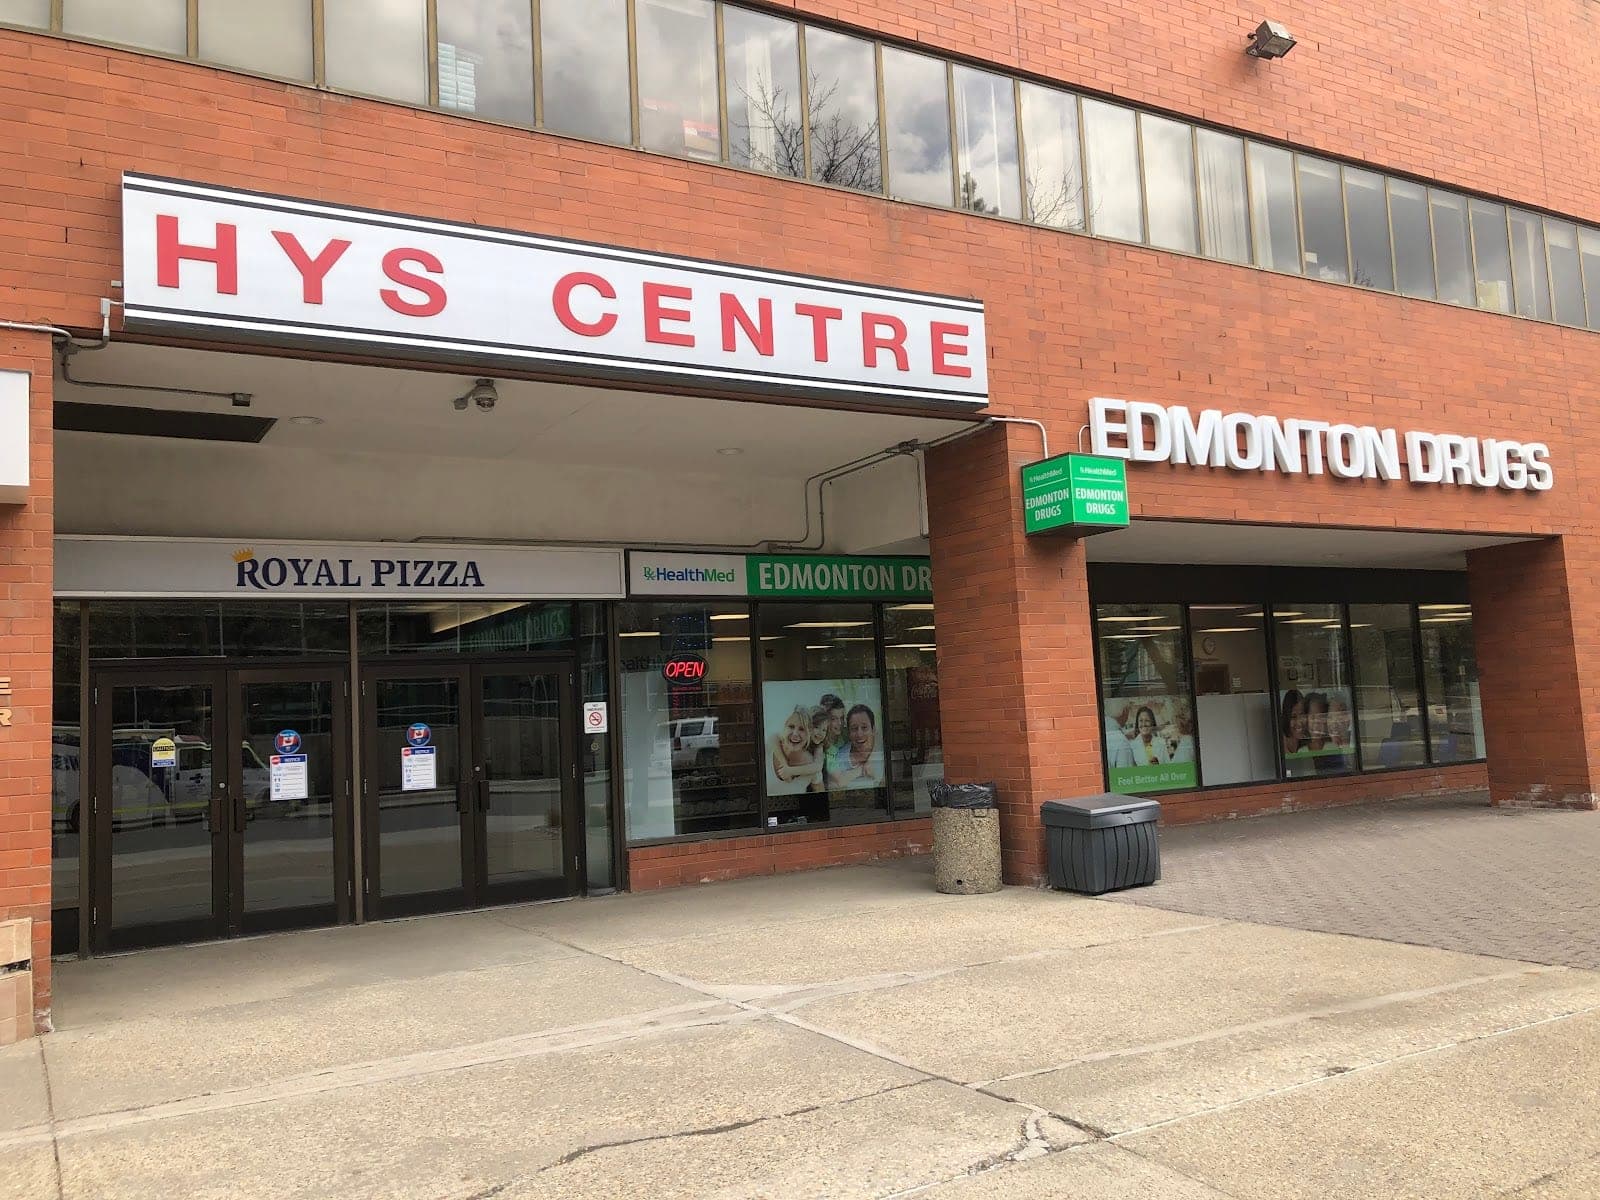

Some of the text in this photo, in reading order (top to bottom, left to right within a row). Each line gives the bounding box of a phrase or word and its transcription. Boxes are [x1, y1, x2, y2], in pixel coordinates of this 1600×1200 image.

[156, 214, 972, 378] HYS CENTRE
[1088, 396, 1554, 490] EDMONTON DRUGS
[1025, 487, 1070, 509] EDMONTON
[1075, 487, 1124, 502] EDMONTON
[1035, 504, 1062, 521] DRUGS
[1086, 502, 1116, 515] DRUGS
[236, 557, 485, 589] ROYAL PIZZA
[656, 567, 735, 583] HealthMed
[758, 562, 896, 591] EDMONTON
[665, 661, 705, 678] OPEN
